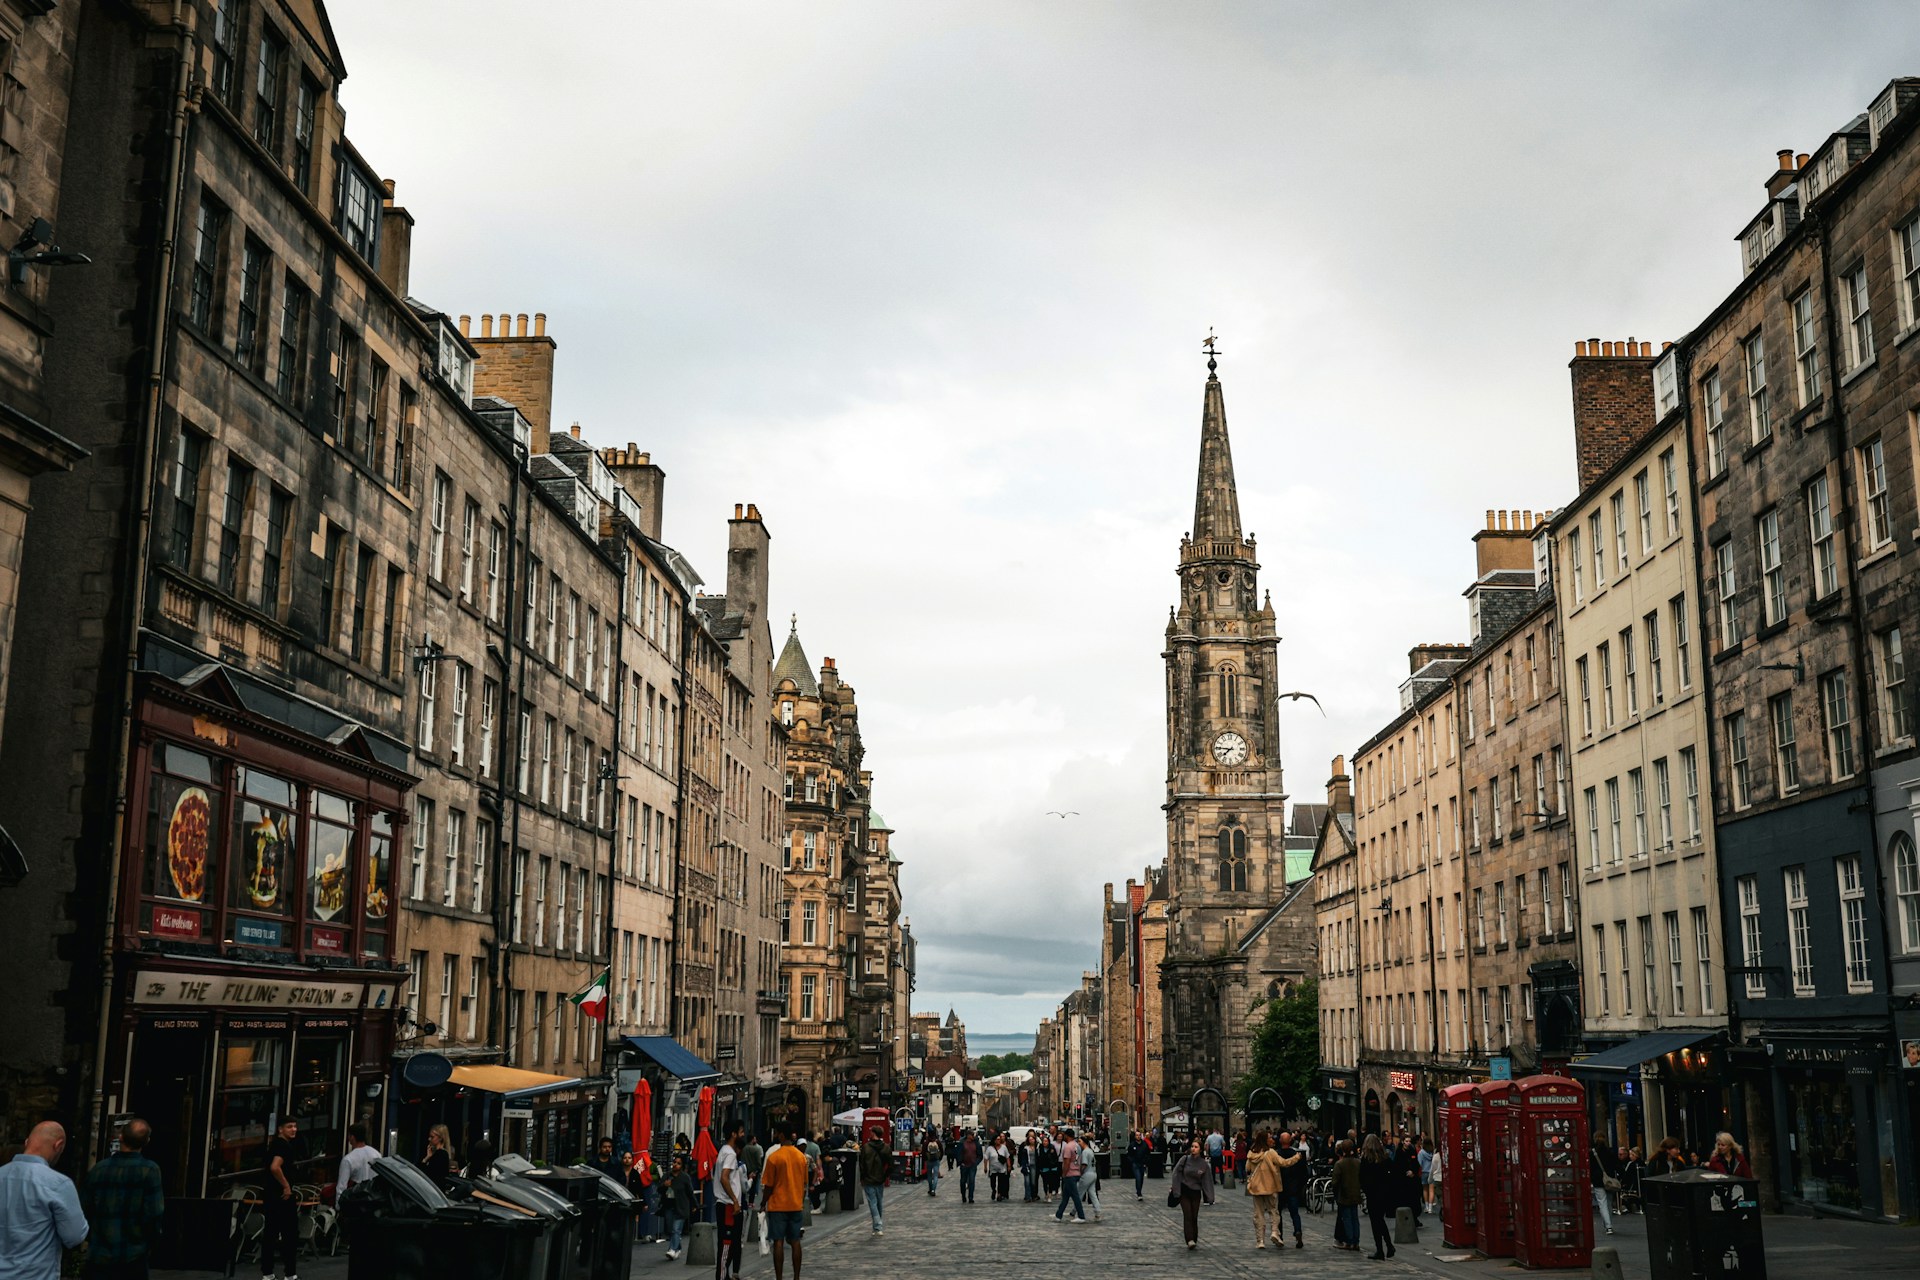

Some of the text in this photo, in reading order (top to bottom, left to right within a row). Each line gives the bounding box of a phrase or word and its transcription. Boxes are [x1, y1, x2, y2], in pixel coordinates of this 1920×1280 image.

[179, 981, 336, 1004] THE FILLING STATION
[154, 1020, 199, 1028] FILLING STATION
[229, 1020, 244, 1028] PIZZA
[246, 1021, 263, 1029] PASTA
[1530, 1096, 1578, 1104] TELEPHONE
